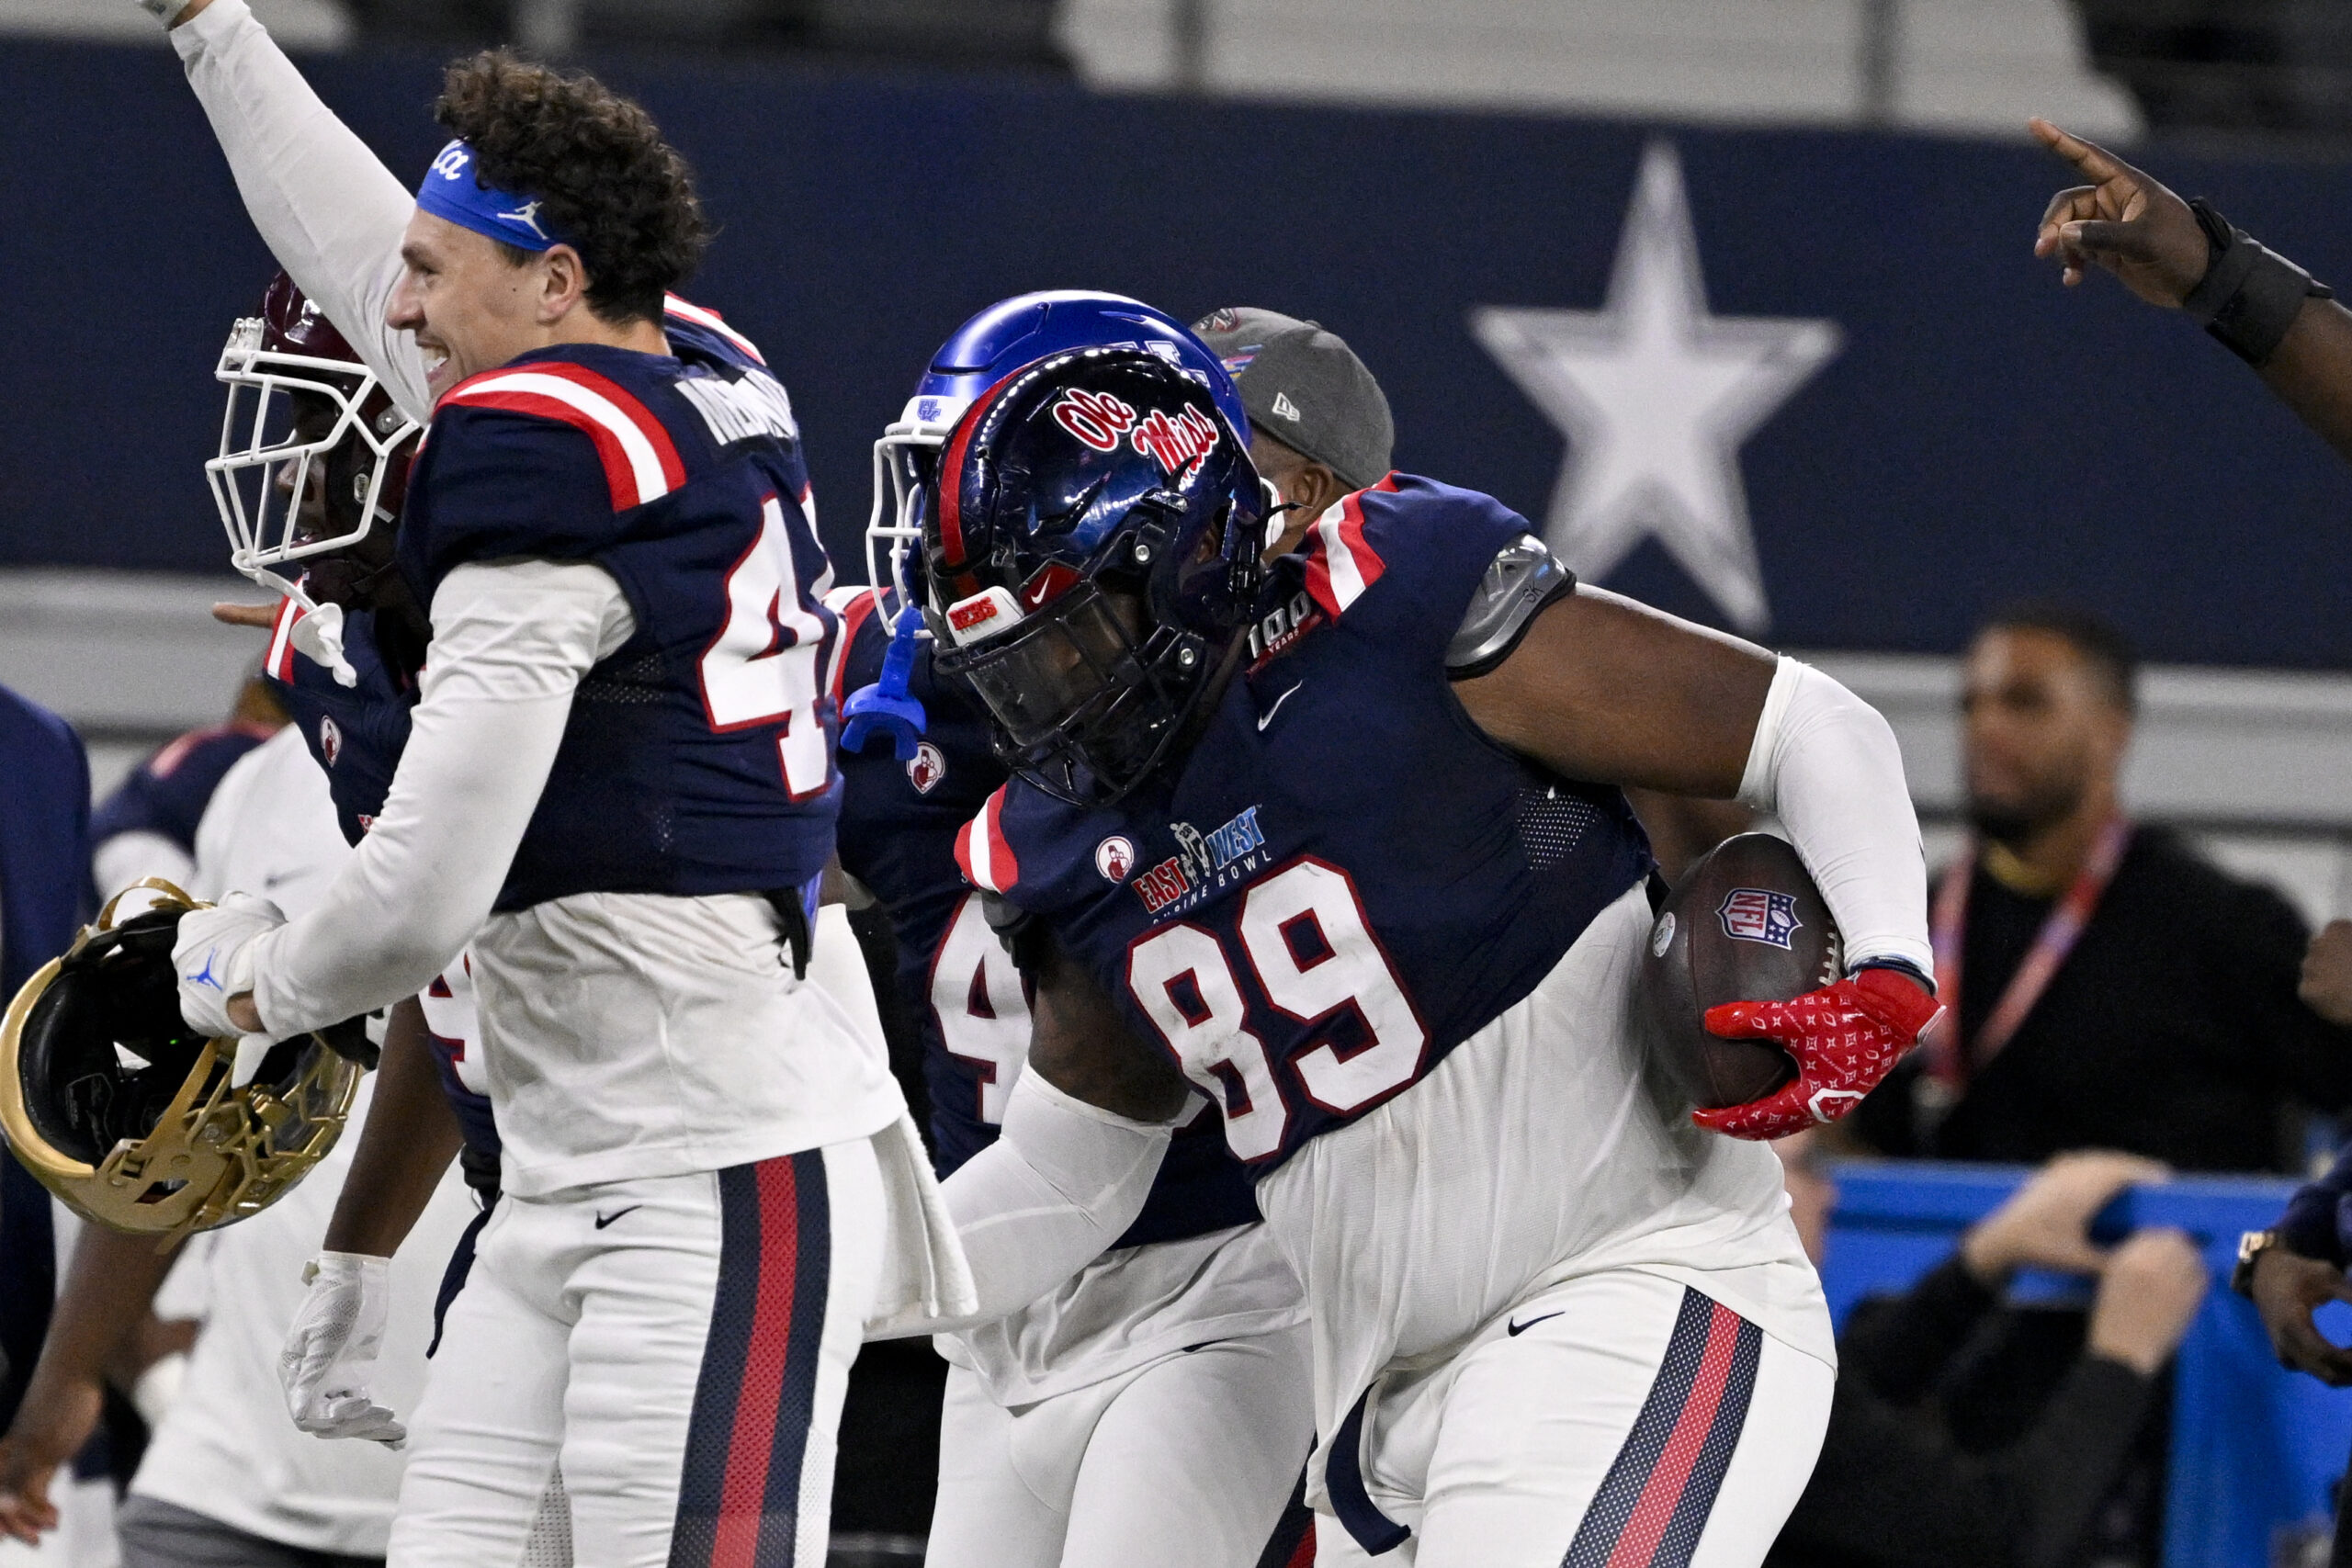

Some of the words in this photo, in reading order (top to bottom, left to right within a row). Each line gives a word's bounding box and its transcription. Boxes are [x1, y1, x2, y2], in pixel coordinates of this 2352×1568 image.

[1053, 388, 1136, 452] Ole
[1131, 402, 1219, 484] Miss
[1248, 591, 1311, 660] 100
[1268, 628, 1300, 654] YEARS
[1131, 856, 1190, 914] EAST
[1204, 806, 1265, 871] WEST
[1218, 851, 1272, 887] BOWL
[1728, 893, 1767, 933] NFL
[1125, 853, 1431, 1163] 89
